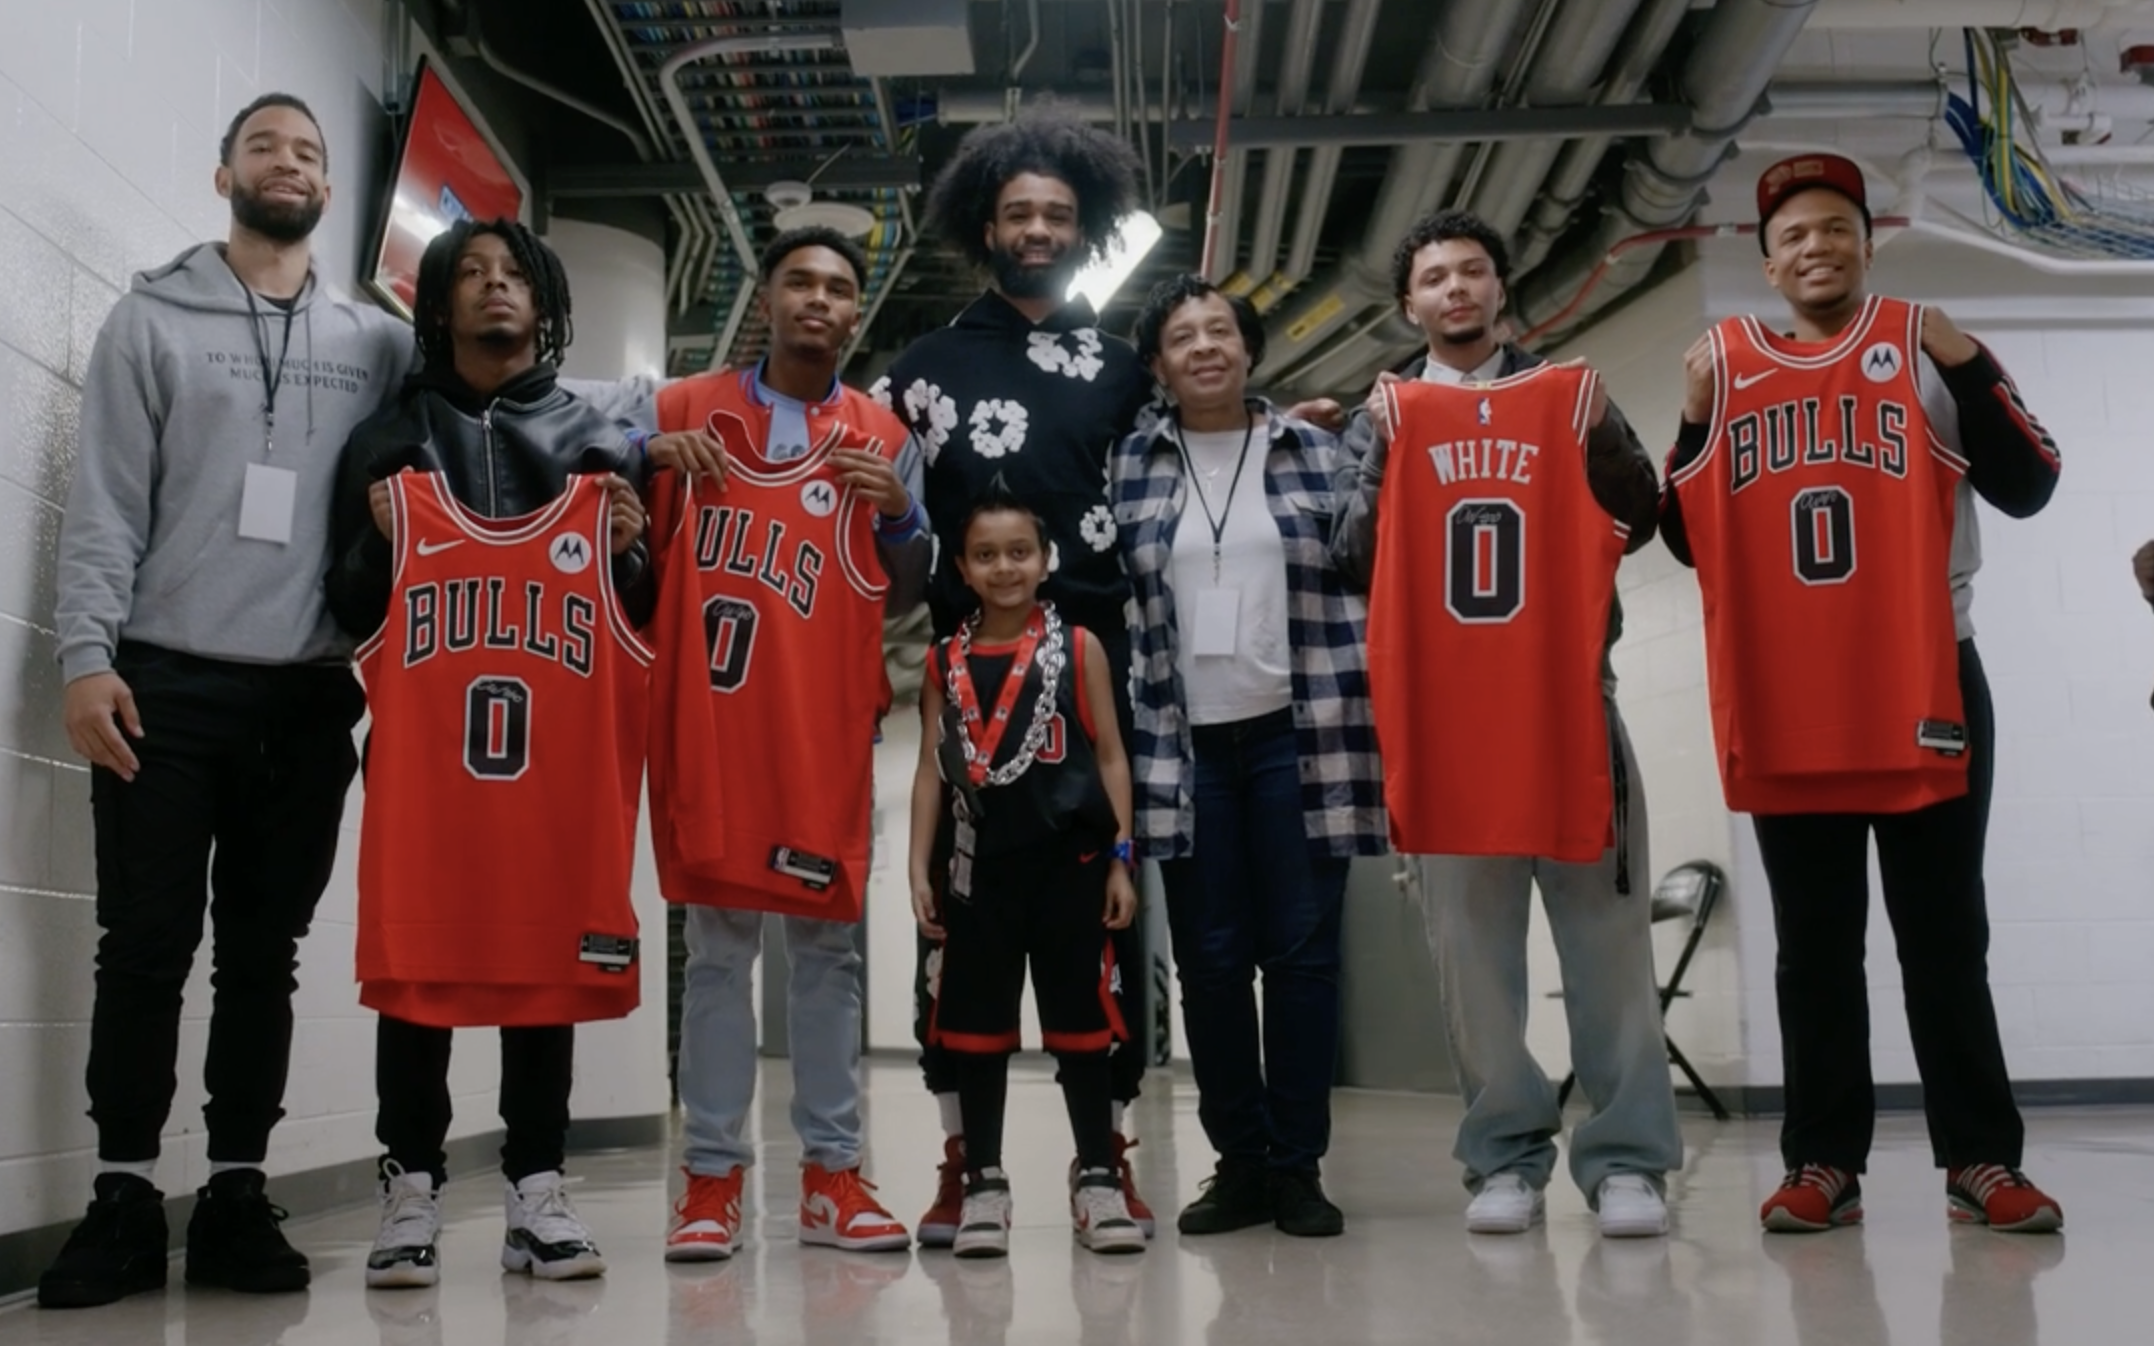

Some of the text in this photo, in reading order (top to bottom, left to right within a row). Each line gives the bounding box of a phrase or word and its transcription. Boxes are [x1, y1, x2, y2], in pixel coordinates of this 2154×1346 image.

[207, 352, 226, 364] TO
[230, 353, 276, 368] WHO
[322, 360, 334, 374] IS
[336, 363, 368, 382] GIVEN
[230, 367, 270, 382] MUC
[294, 373, 359, 395] EXPECTED
[1427, 438, 1540, 486] WHITE
[1728, 395, 1908, 495] BULLS
[694, 505, 825, 620] ULLS
[1444, 498, 1526, 624] 0
[1790, 485, 1858, 586] 0
[404, 576, 596, 678] BULLS
[702, 594, 760, 694] 0
[463, 674, 532, 781] 0
